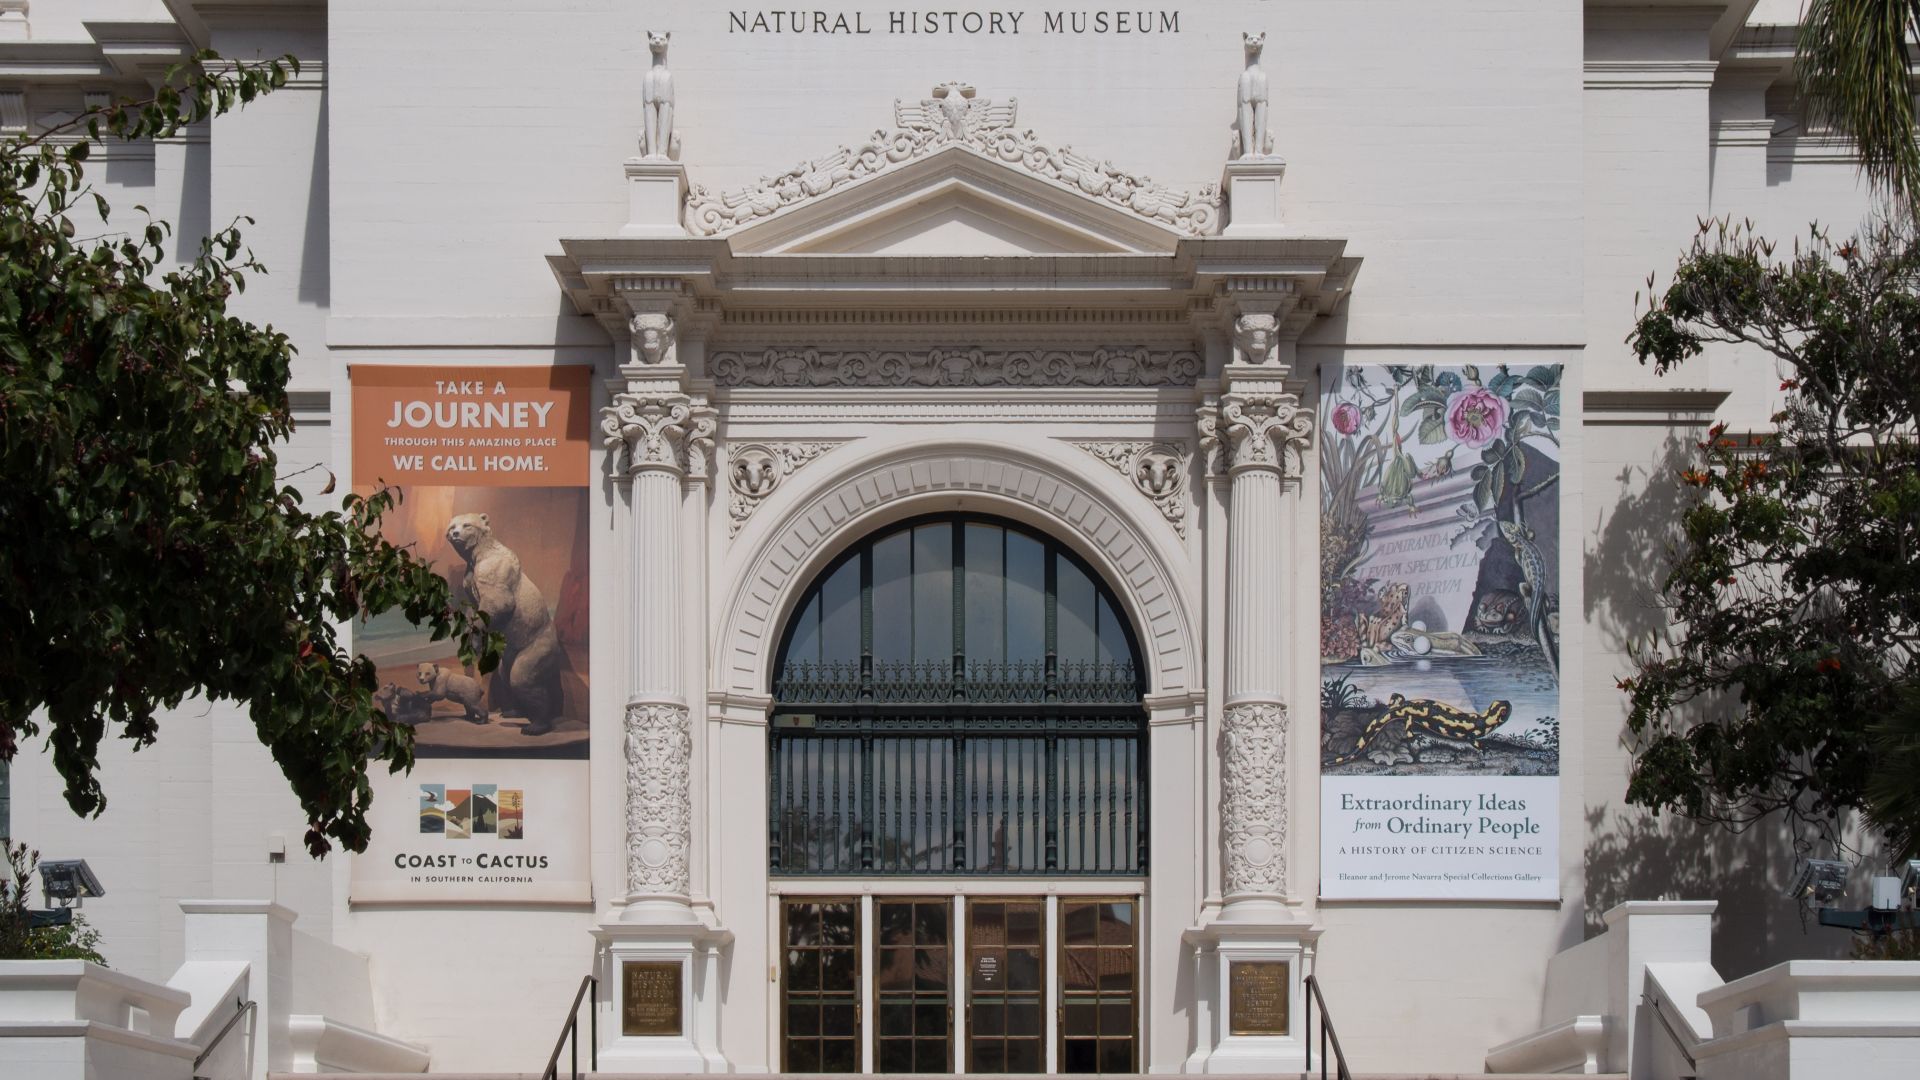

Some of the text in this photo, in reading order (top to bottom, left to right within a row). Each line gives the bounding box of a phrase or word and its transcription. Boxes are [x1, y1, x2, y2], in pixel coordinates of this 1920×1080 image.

[729, 11, 1179, 34] NATURAL HISTORY MUSEUM
[436, 381, 506, 395] TAKE A
[387, 401, 553, 428] JOURNEY
[384, 437, 557, 447] THROUGH THIS AMAZING PLACE
[393, 455, 548, 471] WE CALL HOME.
[1376, 533, 1449, 556] ADMIRANDA
[1404, 551, 1478, 574] SPECTACVLA
[1415, 578, 1462, 595] RERVM
[1341, 793, 1526, 816] Extraordinary Ideas
[1353, 815, 1539, 839] from Ordinary People
[1338, 846, 1542, 856] A HISTORY OF CITIZEN SCIENCE
[395, 853, 548, 869] COAST TO CACTUS
[410, 875, 533, 883] IN SOUTHERN CALIFORNIA
[1338, 872, 1542, 883] Eleanor and Jerome Navarra Special Collections Gallery
